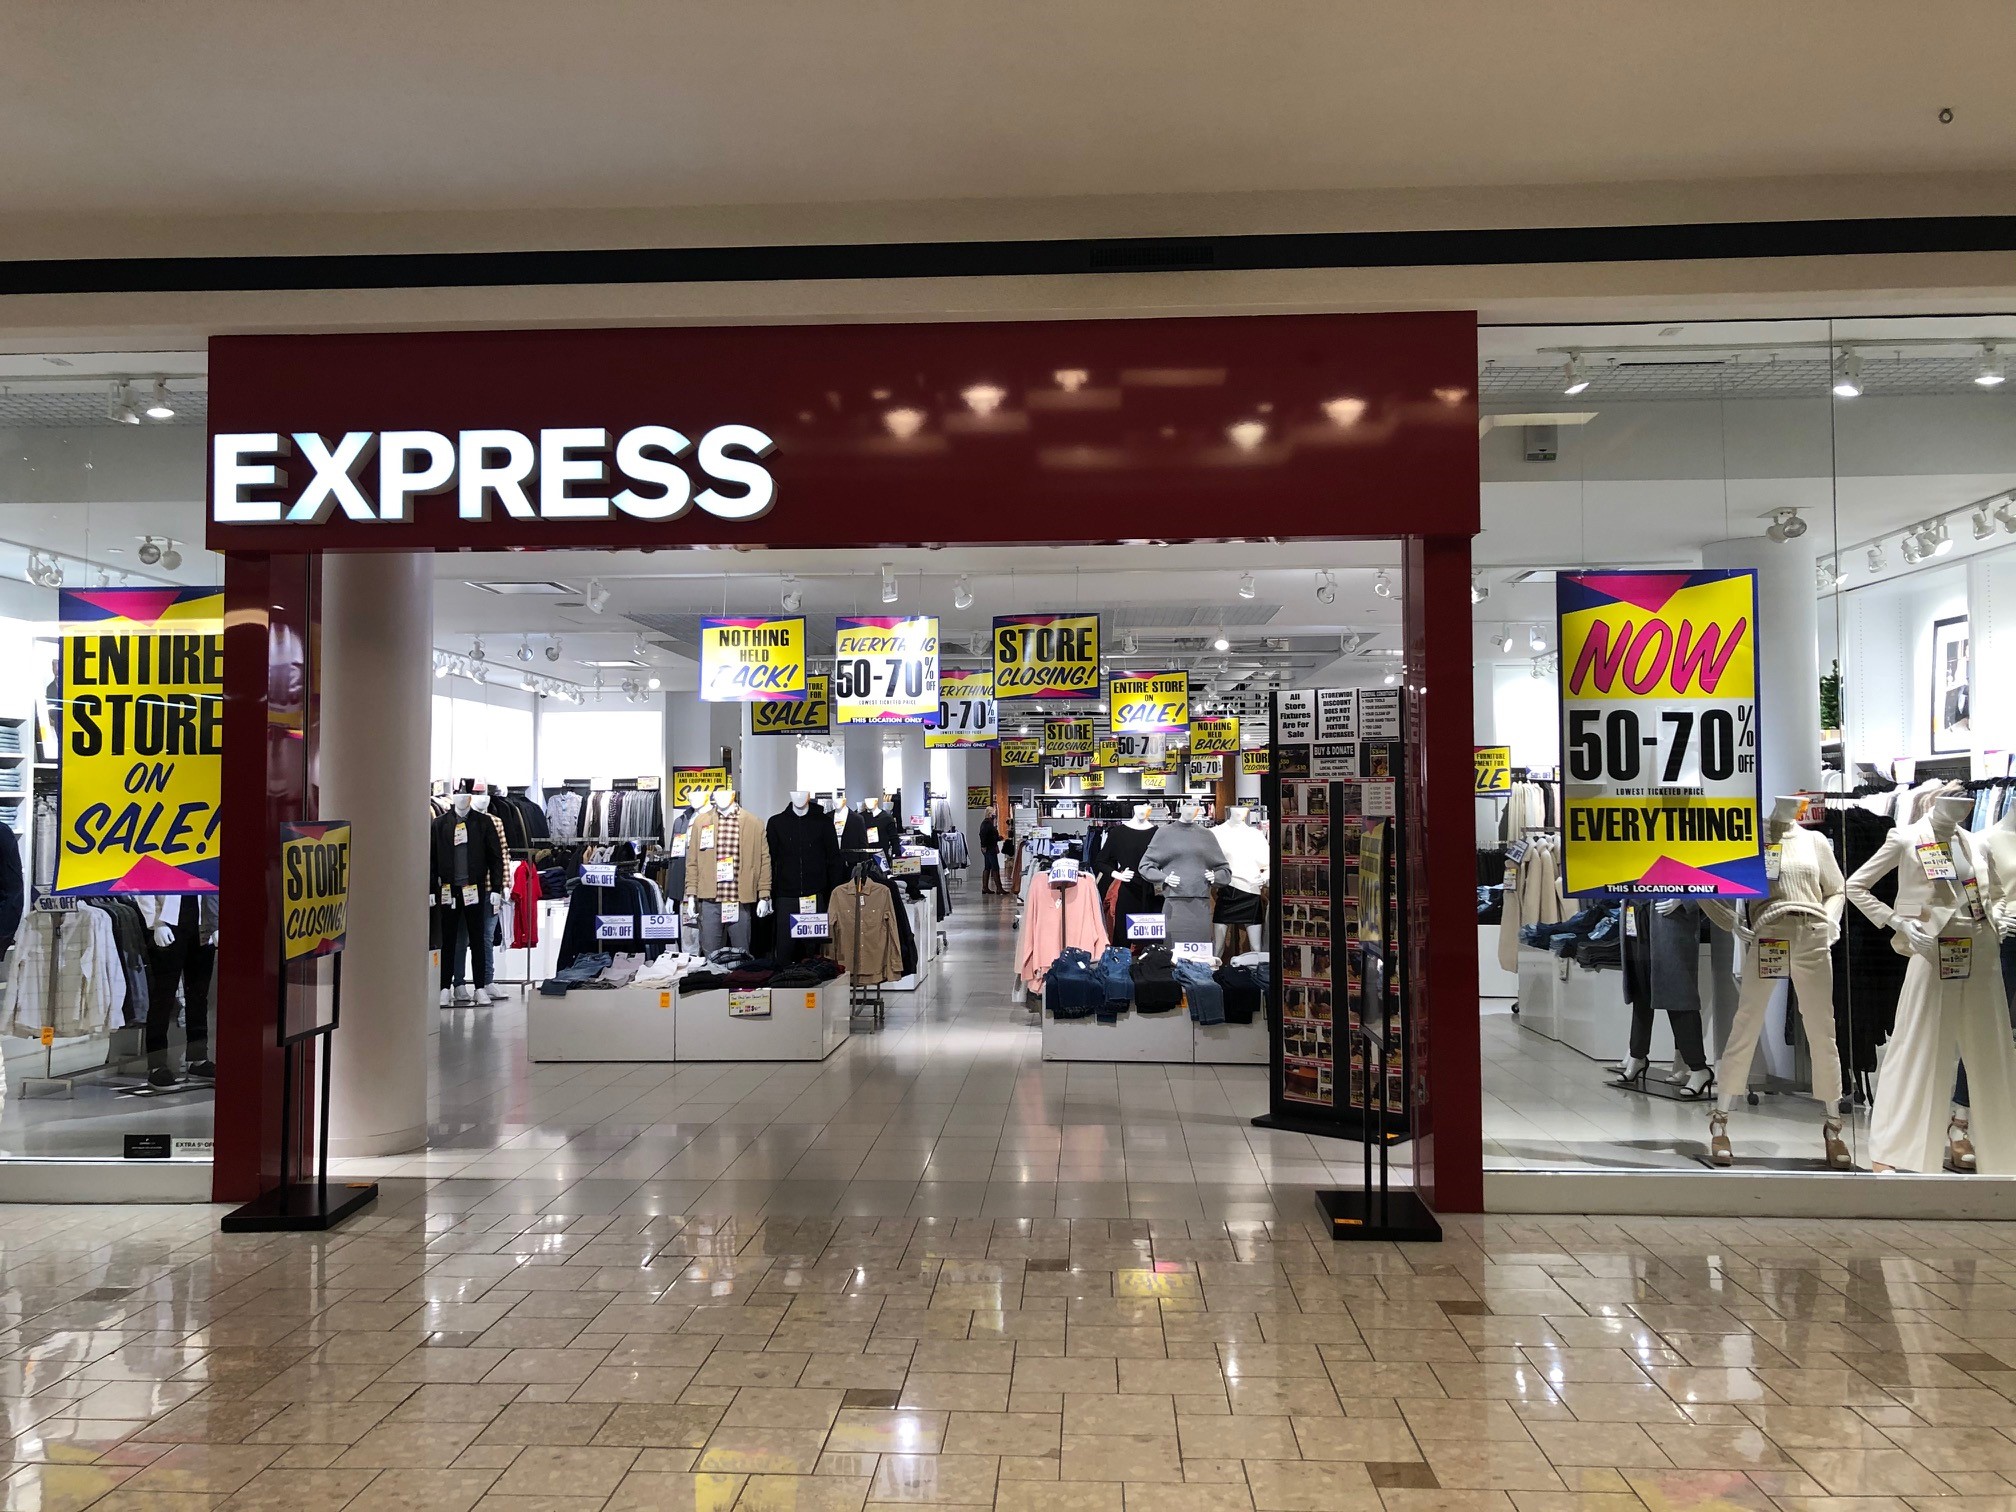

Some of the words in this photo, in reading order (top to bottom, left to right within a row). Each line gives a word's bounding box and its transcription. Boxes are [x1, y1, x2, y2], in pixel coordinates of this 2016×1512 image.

[213, 424, 778, 523] EXPRESS
[719, 629, 790, 647] NOTHING
[999, 628, 1093, 663] STORE
[72, 629, 224, 684] ENTIRE
[740, 649, 769, 662] HELD
[1569, 617, 1747, 696] NOW
[997, 666, 1097, 686] CLOSING!
[926, 681, 936, 691] OFF
[1114, 682, 1149, 693] ENTIRE
[1152, 681, 1184, 692] STORE
[757, 701, 827, 726] SALE
[1115, 703, 1185, 723] SALE!
[72, 694, 223, 756] STORE
[1047, 724, 1090, 740] STORE
[1198, 722, 1231, 731] NOTHING
[1047, 742, 1093, 750] CLOSING!
[1195, 739, 1235, 750] BACK!
[1314, 747, 1325, 755] BUY
[1326, 747, 1330, 755] &
[1332, 746, 1353, 755] DONATE
[1003, 751, 1037, 763] SALE
[1738, 754, 1754, 773] OFF
[124, 762, 175, 793] ON
[1616, 788, 1645, 796] LOWEST
[1648, 788, 1682, 796] TICKETED
[1684, 788, 1704, 796] PRICE
[66, 802, 220, 854] SALE!
[1570, 807, 1753, 842] EVERYTHING!
[287, 843, 347, 901] STORE
[1052, 869, 1066, 879] 50%
[1068, 869, 1078, 879] OFF
[586, 875, 599, 884] 50%
[601, 875, 613, 884] OFF
[1607, 884, 1629, 893] THIS
[1633, 884, 1685, 893] LOCATION
[1688, 884, 1715, 893] ONLY
[40, 898, 58, 910] 50%
[60, 897, 75, 909] OFF
[287, 902, 346, 940] CLOSING!
[602, 926, 617, 936] 50%
[619, 926, 632, 936] OFF
[797, 925, 812, 935] 50%
[814, 924, 827, 934] OFF
[1134, 926, 1149, 936] 50%
[1151, 925, 1164, 935] OFF
